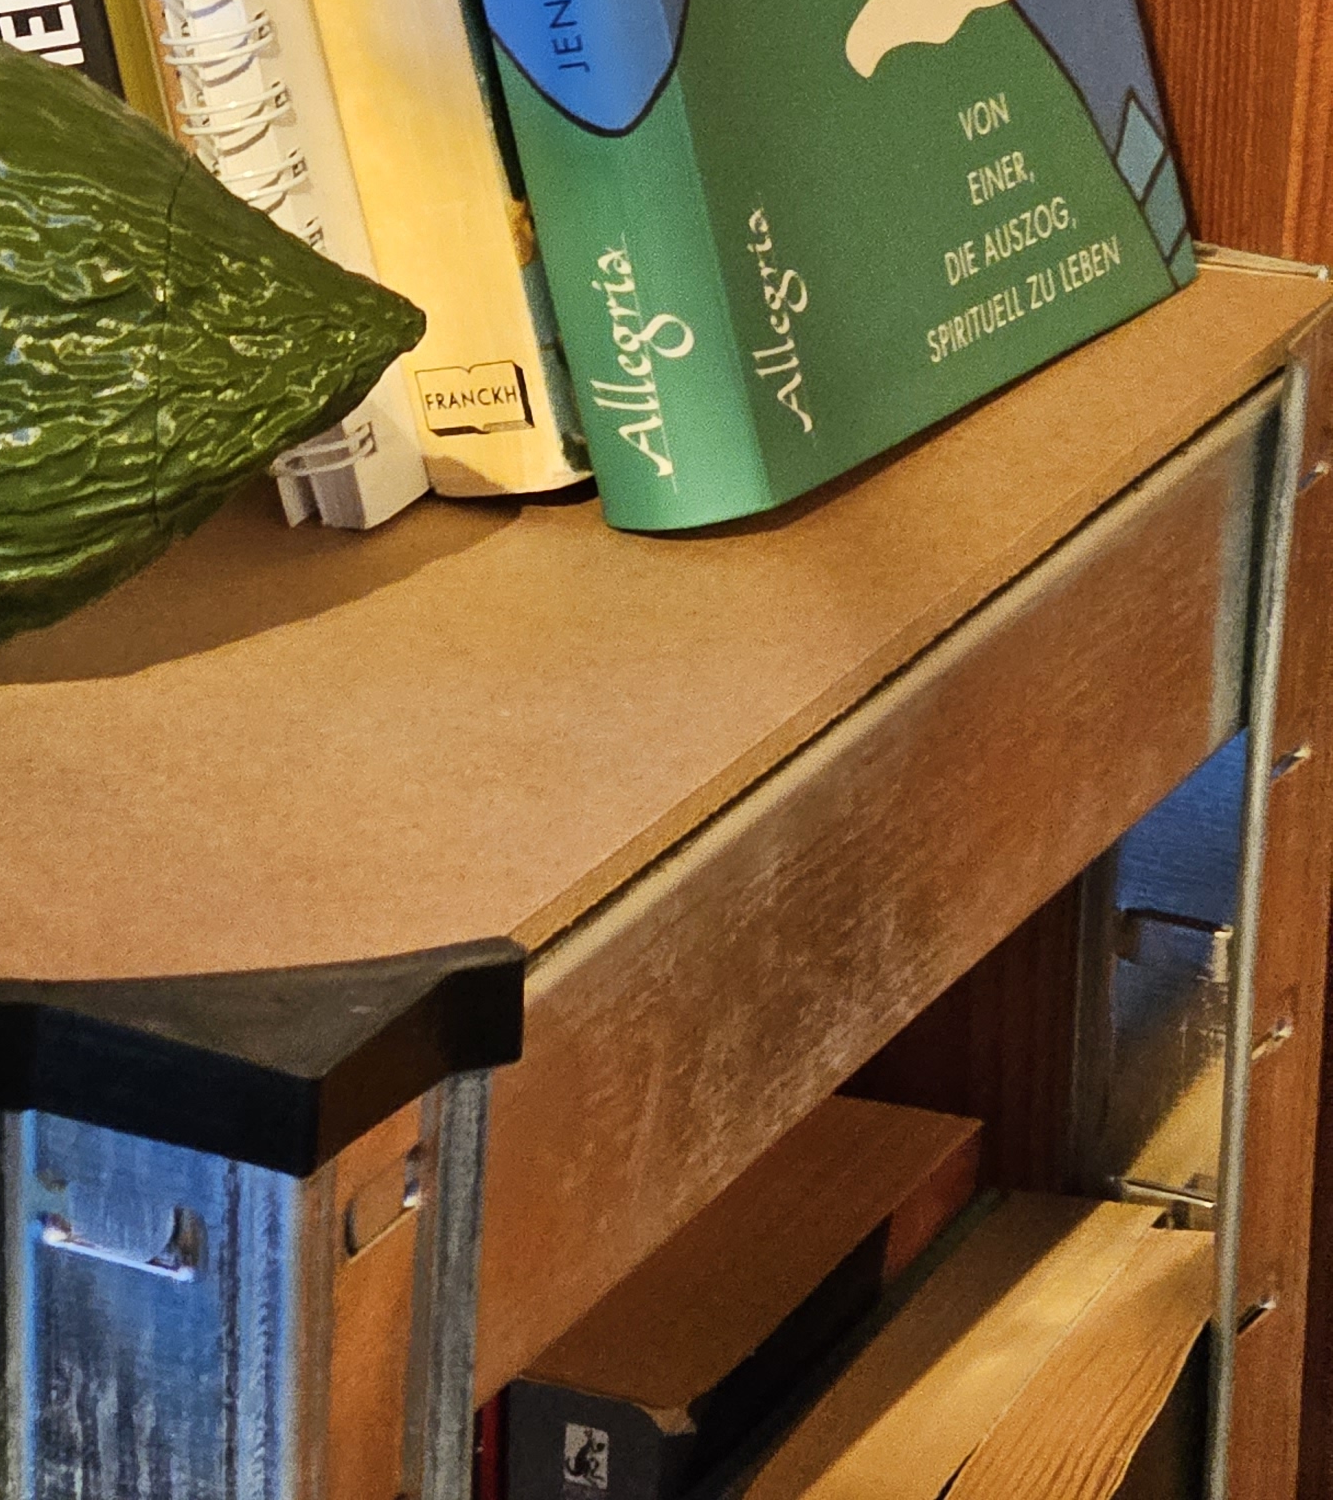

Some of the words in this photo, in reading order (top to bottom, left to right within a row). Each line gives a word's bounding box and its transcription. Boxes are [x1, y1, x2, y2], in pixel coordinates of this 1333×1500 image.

[957, 92, 1011, 141] VON
[966, 150, 1035, 206] EINER,
[943, 239, 980, 286] DIE
[983, 195, 1078, 265] AUSZOG,
[748, 205, 818, 440] Allegria
[926, 283, 1025, 364] SPIRITUELL
[1025, 273, 1057, 310] ZU
[1058, 234, 1122, 292] LEBEN
[424, 386, 519, 414] FRANCKH
[590, 235, 696, 485] Allegria
